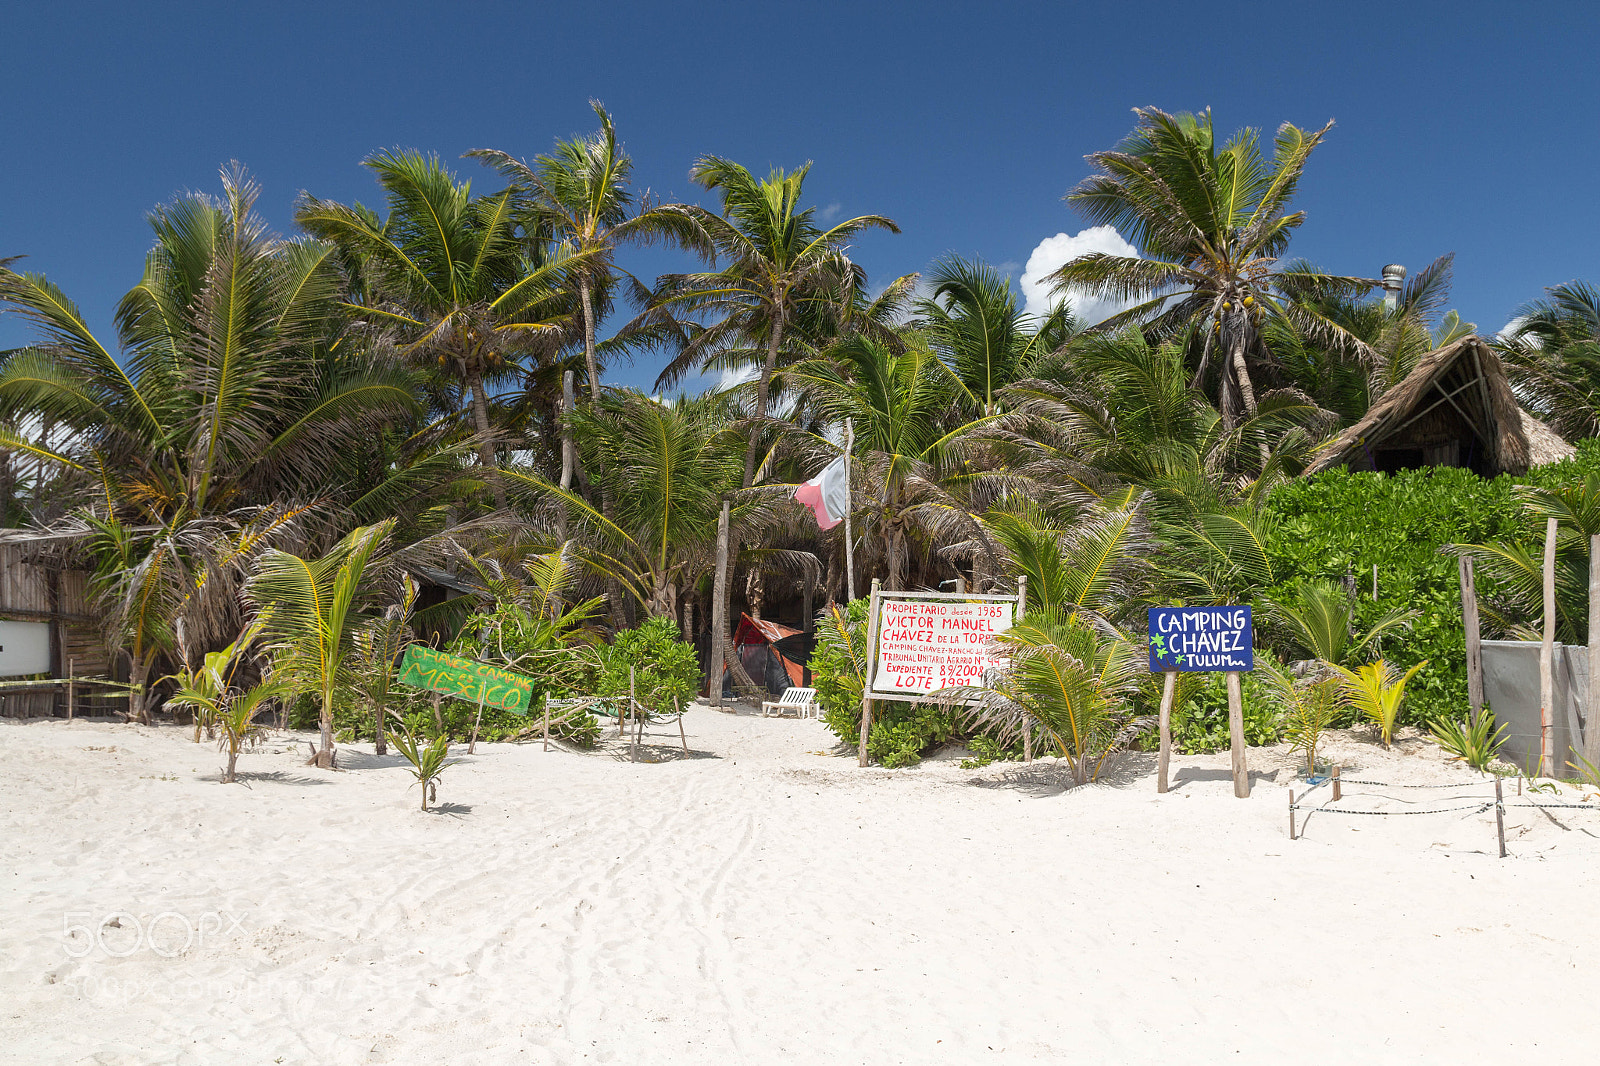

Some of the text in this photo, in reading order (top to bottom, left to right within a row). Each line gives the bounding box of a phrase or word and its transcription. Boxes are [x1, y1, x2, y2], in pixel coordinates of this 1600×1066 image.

[886, 603, 1003, 618] PROPIETARIO desde 1985
[886, 615, 994, 632] VICTOR MANUEL
[1158, 609, 1246, 633] CAMPING
[882, 642, 918, 652] CAMPING
[937, 635, 948, 644] DE
[950, 635, 960, 644] LA
[1169, 629, 1245, 654] CHÁVEZ
[881, 652, 917, 663] TRIBUNAL
[917, 654, 945, 665] UNITARIO
[946, 656, 973, 665] AGRARIO
[1186, 653, 1233, 667] TULUM
[886, 662, 984, 678] EXPEDIENTE 89/2008
[458, 673, 474, 683] ES
[477, 665, 533, 692] CAMPING
[895, 675, 933, 690] LOTE
